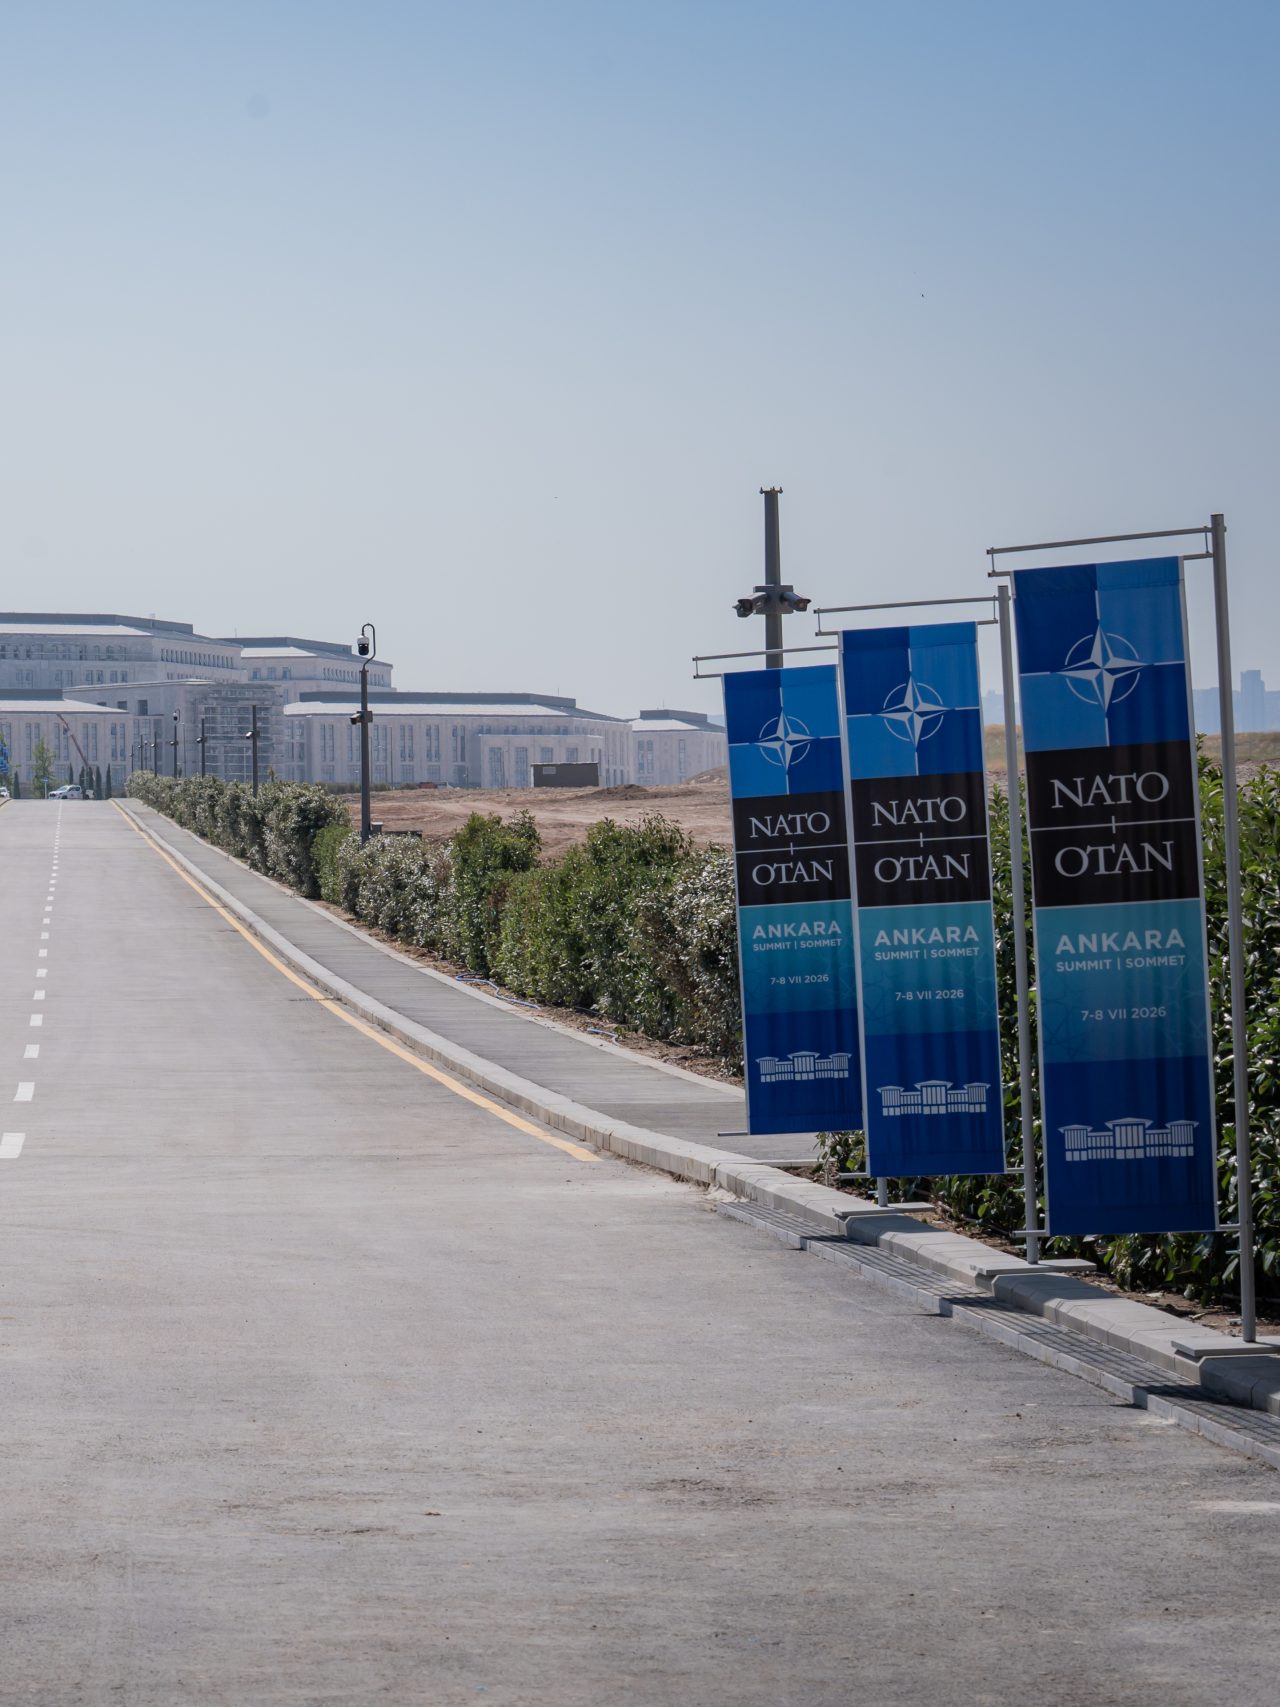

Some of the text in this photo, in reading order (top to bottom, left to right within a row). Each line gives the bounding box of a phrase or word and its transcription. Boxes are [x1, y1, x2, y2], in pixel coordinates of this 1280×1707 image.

[1050, 772, 1169, 808] NATO
[872, 797, 966, 826] NATO
[750, 812, 830, 837] NATO
[875, 854, 969, 882] OTAN
[1055, 841, 1173, 877] OTAN
[752, 860, 832, 885] OTAN
[753, 921, 841, 939] ANKARA
[875, 926, 978, 947] ANKARA
[753, 940, 792, 952] SUMMIT
[800, 937, 842, 949] SOMMET
[1056, 929, 1184, 956] ANKARA
[875, 949, 920, 961] SUMMIT
[931, 946, 980, 959] SOMMET
[1057, 958, 1112, 972] SUMMIT
[1126, 954, 1185, 969] SOMMET
[770, 973, 830, 985] 7-8 VII 2026
[896, 988, 965, 1001] 7-8 VII 2026
[1081, 1006, 1167, 1021] 7-8 VII 2026
